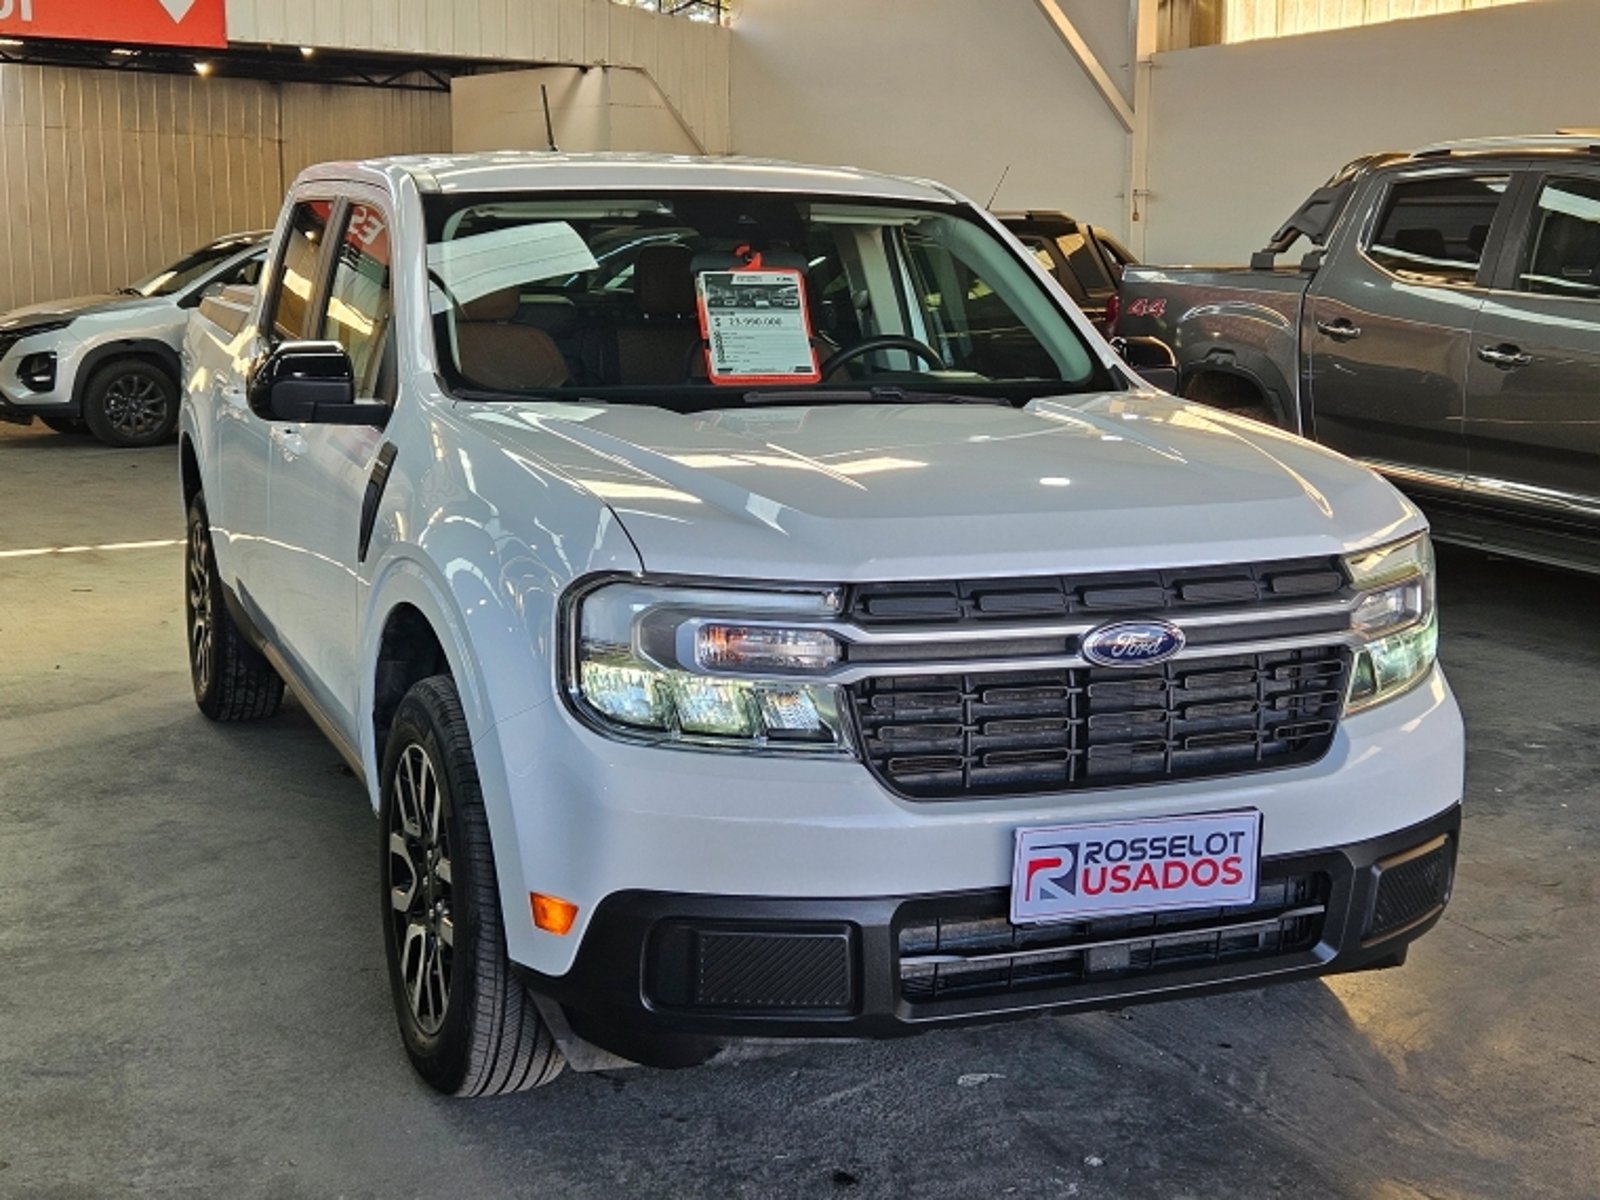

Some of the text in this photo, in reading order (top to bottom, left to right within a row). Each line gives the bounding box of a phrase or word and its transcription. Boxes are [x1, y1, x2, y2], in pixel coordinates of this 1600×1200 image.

[1111, 631, 1163, 657] Ford
[1084, 831, 1245, 865] ROSSELOT
[1082, 857, 1243, 895] USADOS
